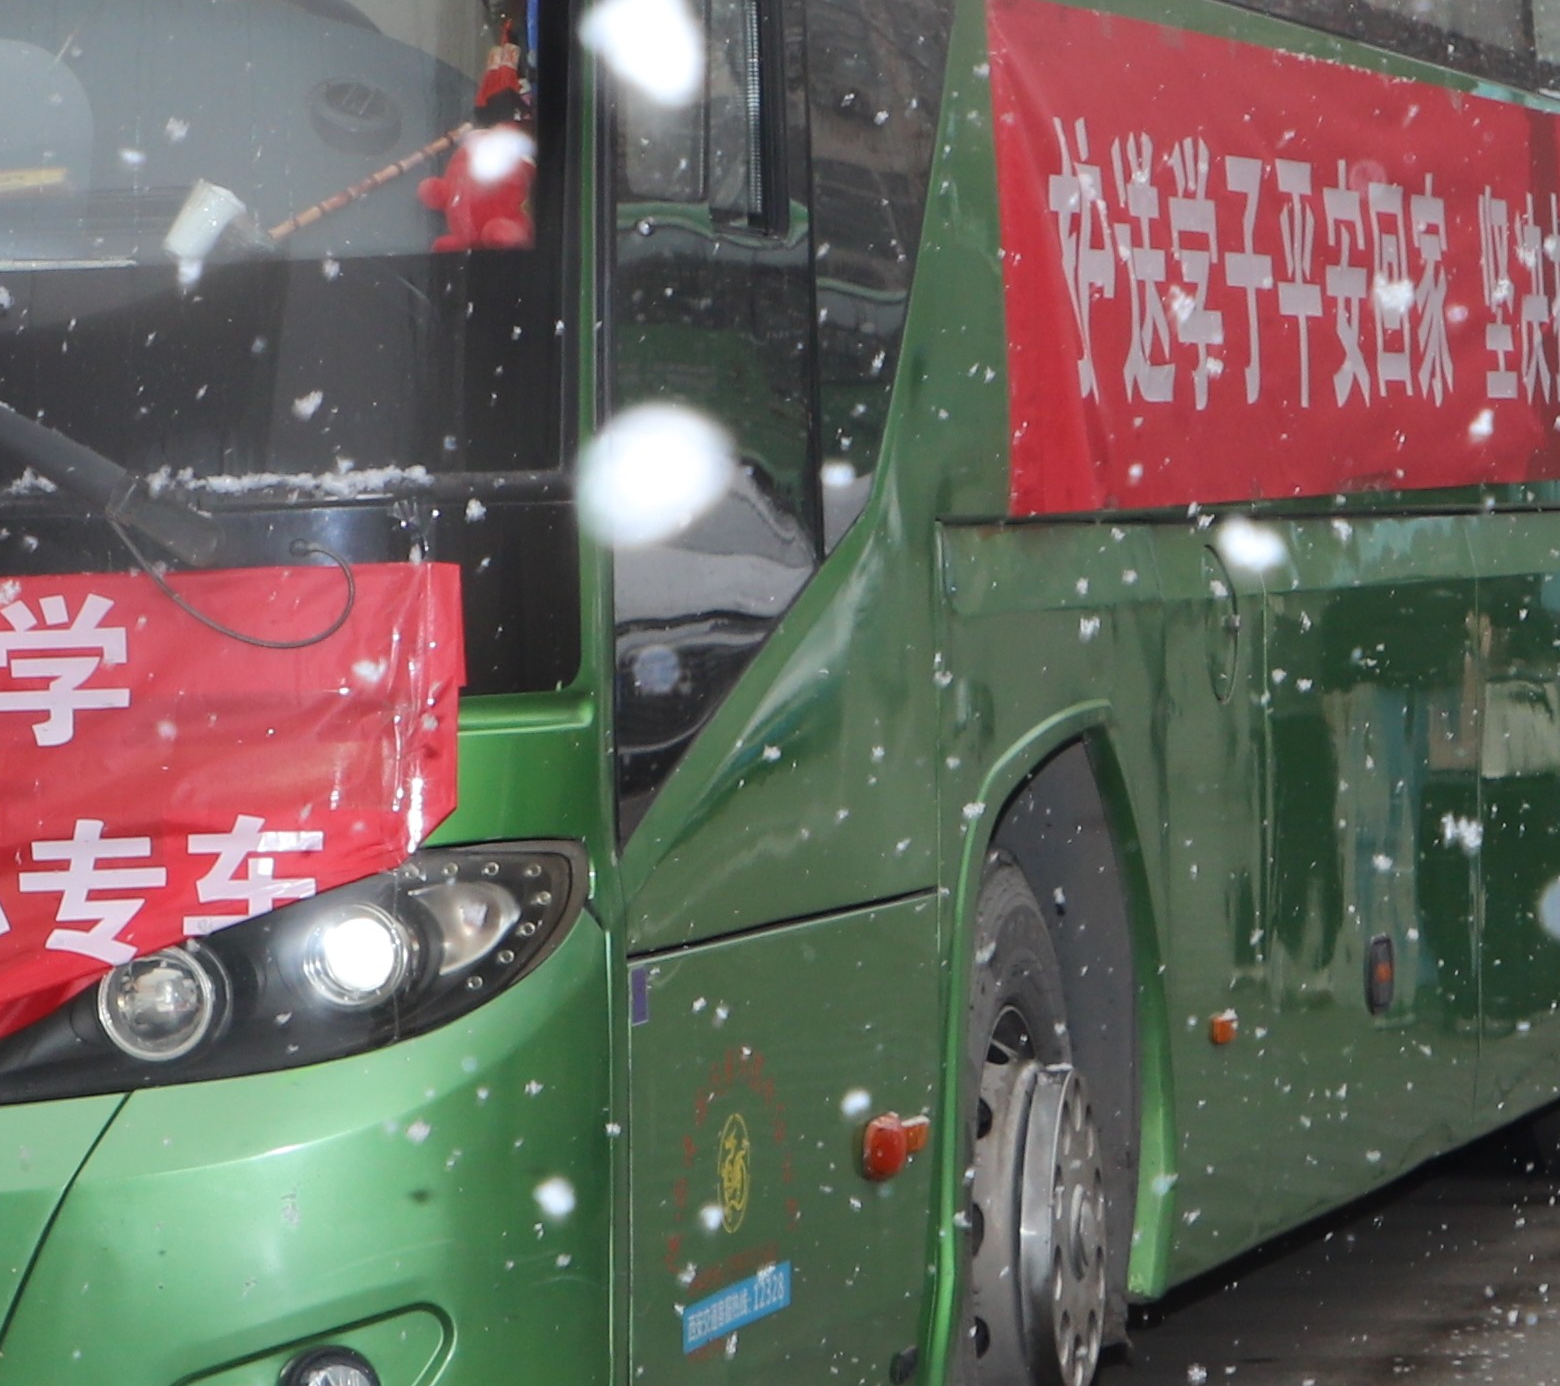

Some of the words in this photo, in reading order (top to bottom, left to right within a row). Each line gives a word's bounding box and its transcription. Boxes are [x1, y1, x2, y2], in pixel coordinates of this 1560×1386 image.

[1048, 117, 1454, 411] 护送学子平安回家
